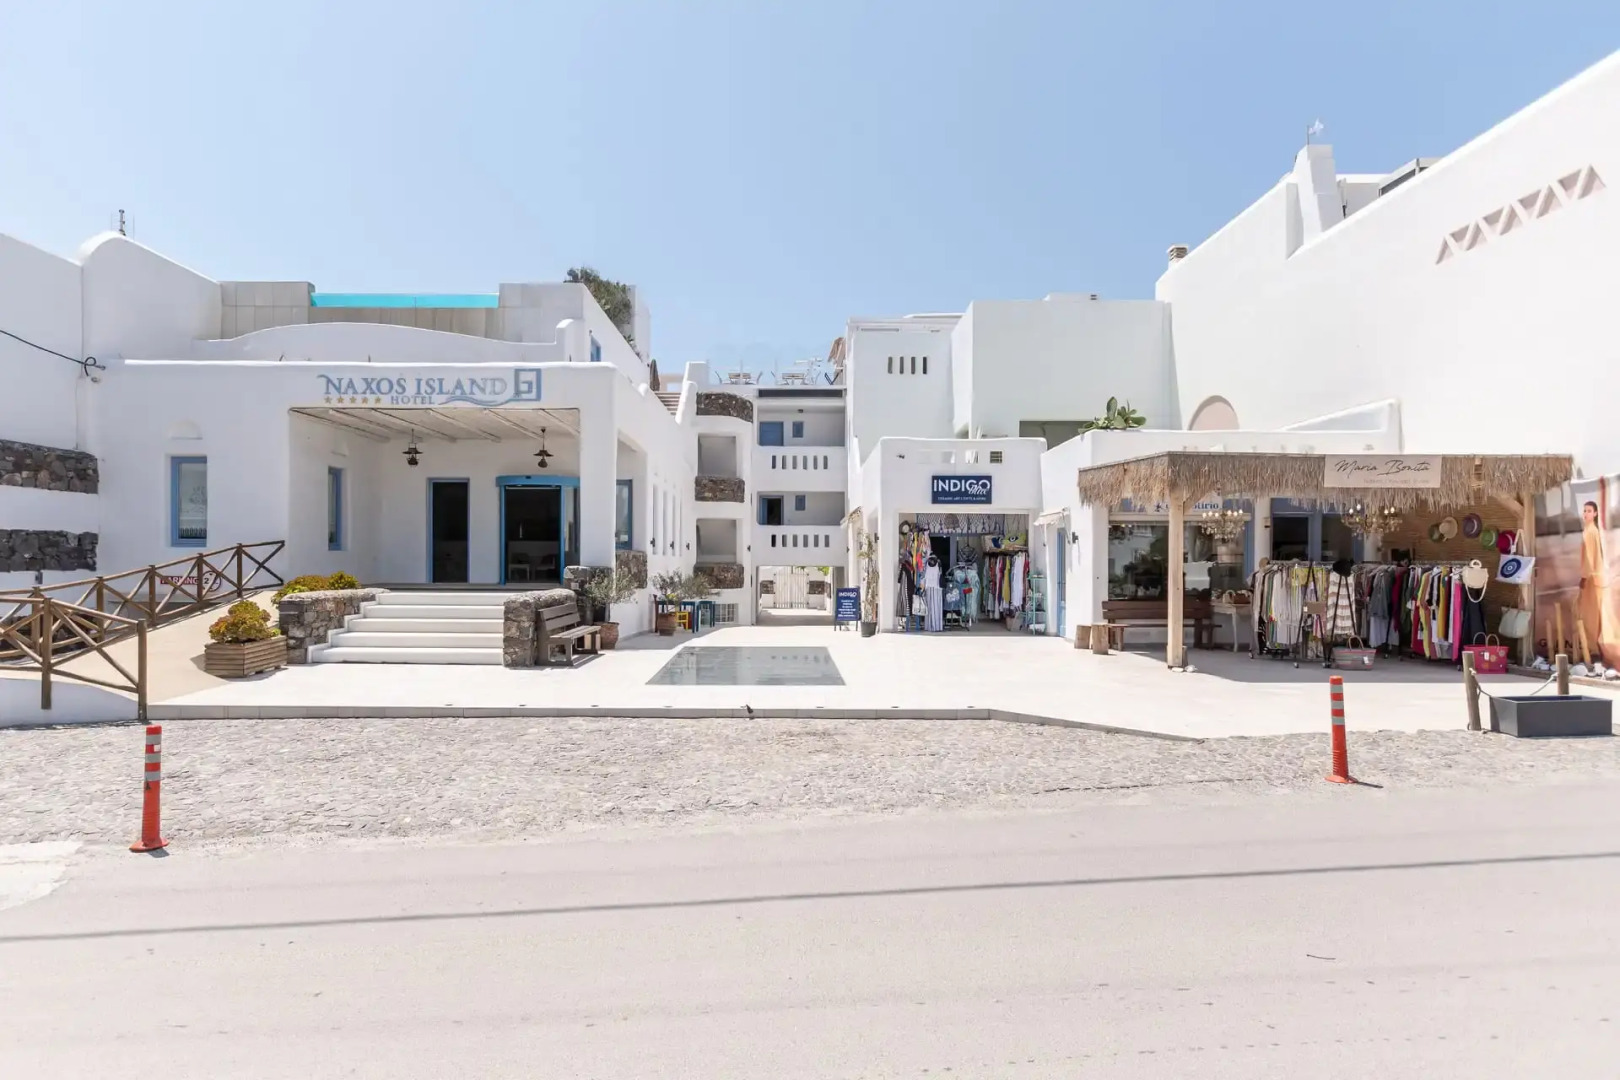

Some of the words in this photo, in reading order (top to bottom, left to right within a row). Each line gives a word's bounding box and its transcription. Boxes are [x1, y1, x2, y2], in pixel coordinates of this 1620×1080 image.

[317, 374, 407, 395] NAXOS
[416, 377, 507, 395] ISLAND
[390, 396, 435, 405] HOTEL
[1334, 459, 1377, 479] Maria
[1376, 459, 1431, 476] Bonita
[934, 479, 990, 491] INDIGO
